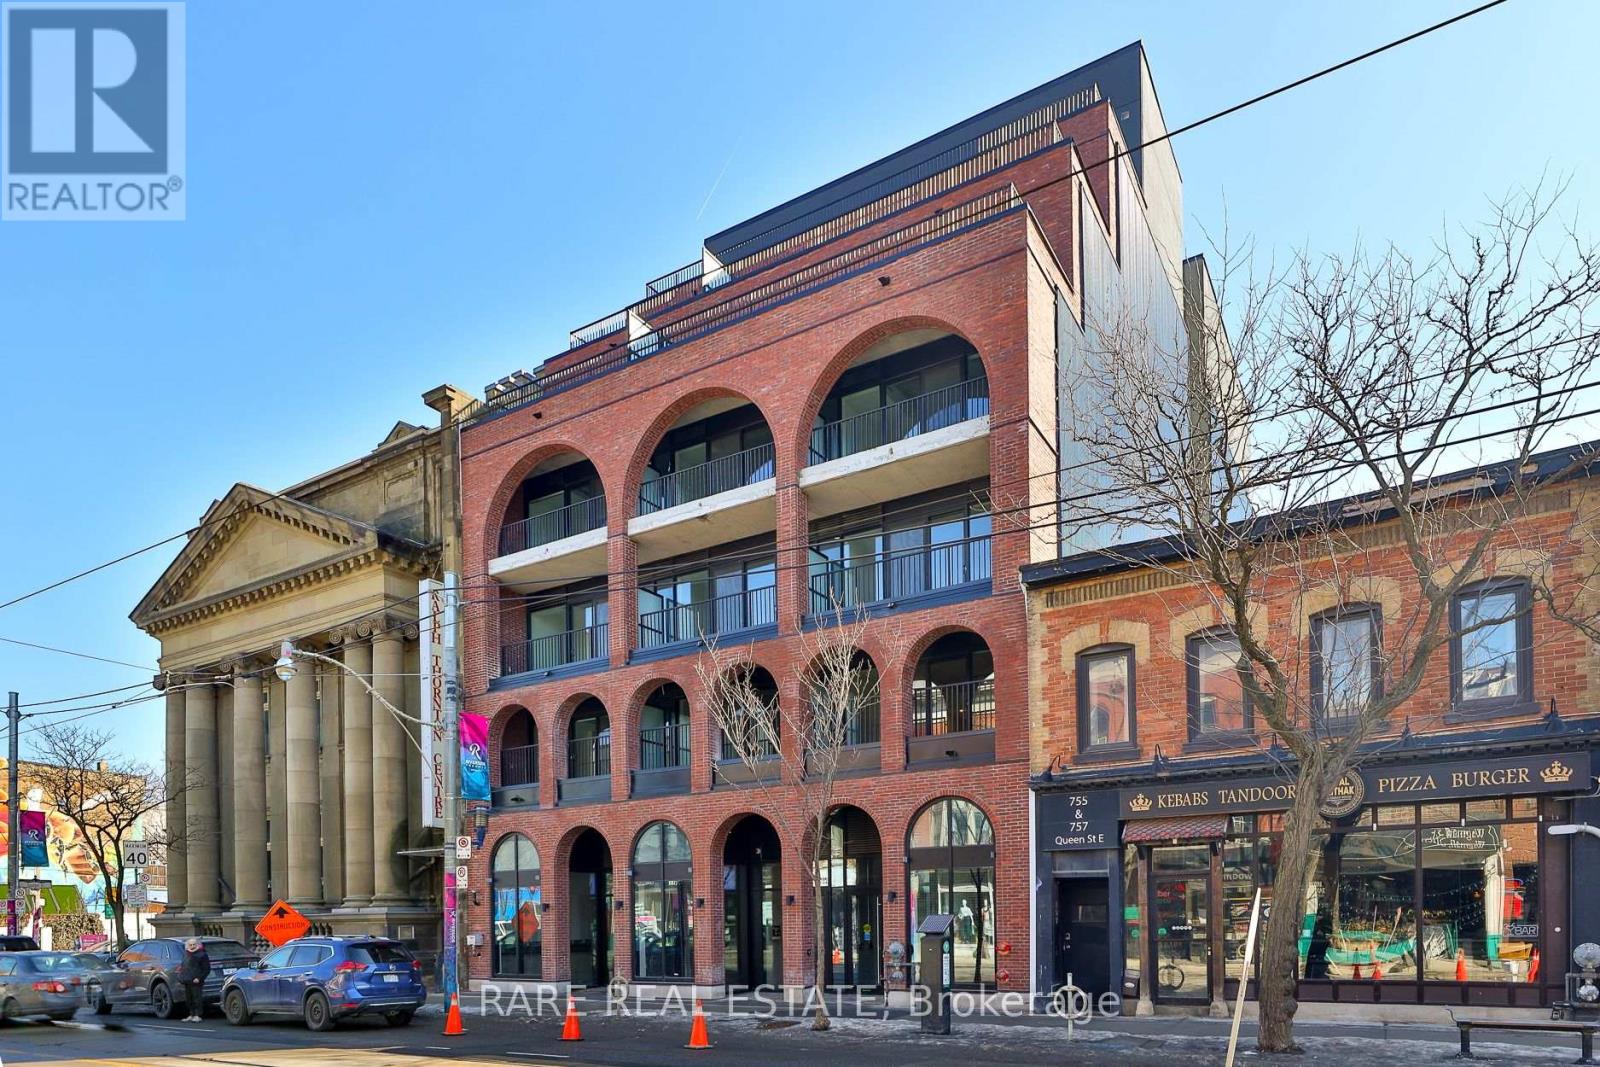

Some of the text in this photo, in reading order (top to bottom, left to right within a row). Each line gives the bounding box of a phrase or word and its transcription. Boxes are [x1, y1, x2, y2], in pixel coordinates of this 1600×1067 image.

[433, 753, 443, 819] CENTRE
[1378, 768, 1530, 793] PIZZA BURGER
[1069, 796, 1088, 807] 755
[1157, 791, 1209, 809] KEBABS
[1074, 809, 1083, 819] &
[1069, 821, 1089, 832] 757
[1055, 834, 1105, 845] Queen St E
[126, 852, 147, 865] 40
[260, 920, 306, 932] CONSTRUCTION
[1514, 925, 1537, 935] BAR
